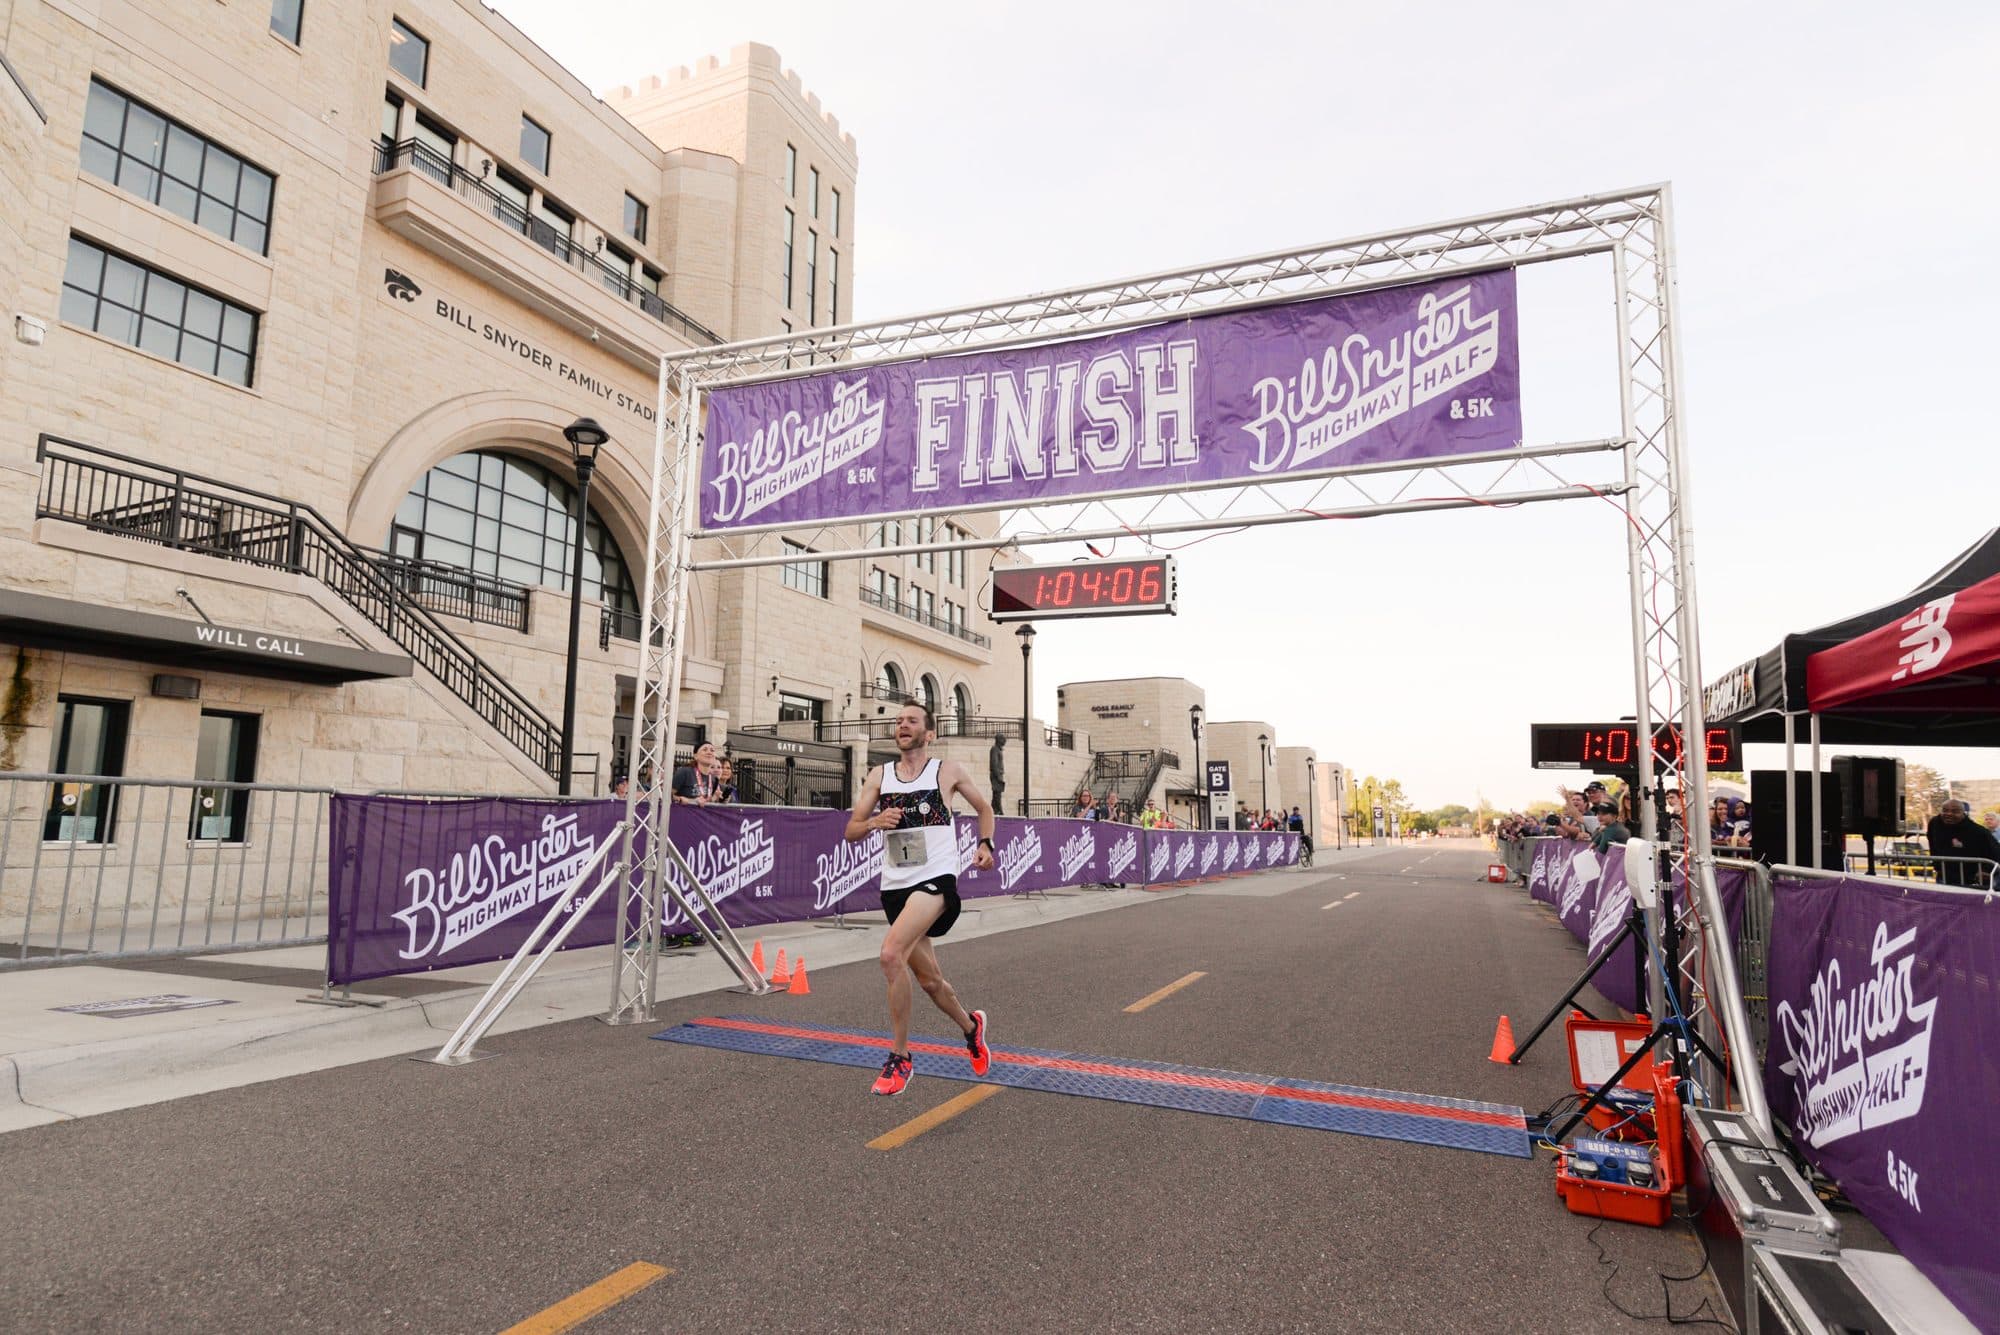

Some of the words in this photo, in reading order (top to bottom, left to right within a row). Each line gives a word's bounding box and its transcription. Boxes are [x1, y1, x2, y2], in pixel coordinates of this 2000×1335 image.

[436, 299, 477, 333] BILL
[483, 324, 553, 371] SNYDER
[559, 362, 613, 400] FAMILY
[1241, 346, 1347, 473] Bill
[1341, 284, 1499, 405] Snyder
[912, 339, 1200, 492] FINISH
[1449, 400, 1465, 420] &
[1467, 397, 1495, 417] 5K
[709, 420, 783, 522] Bill
[777, 376, 886, 470] Snyder
[859, 467, 877, 483] 5K
[1036, 566, 1160, 606] 1:04:06
[196, 625, 248, 647] WILL
[255, 636, 305, 656] CALL
[777, 742, 796, 752] GATE
[1212, 773, 1224, 787] B
[706, 819, 774, 878] Snyder
[902, 846, 908, 860] 1
[391, 844, 488, 960] Bill
[484, 813, 595, 893] Snyder
[762, 885, 773, 896] 5K
[811, 839, 850, 911] Bill
[1899, 1159, 1921, 1213] 5K
